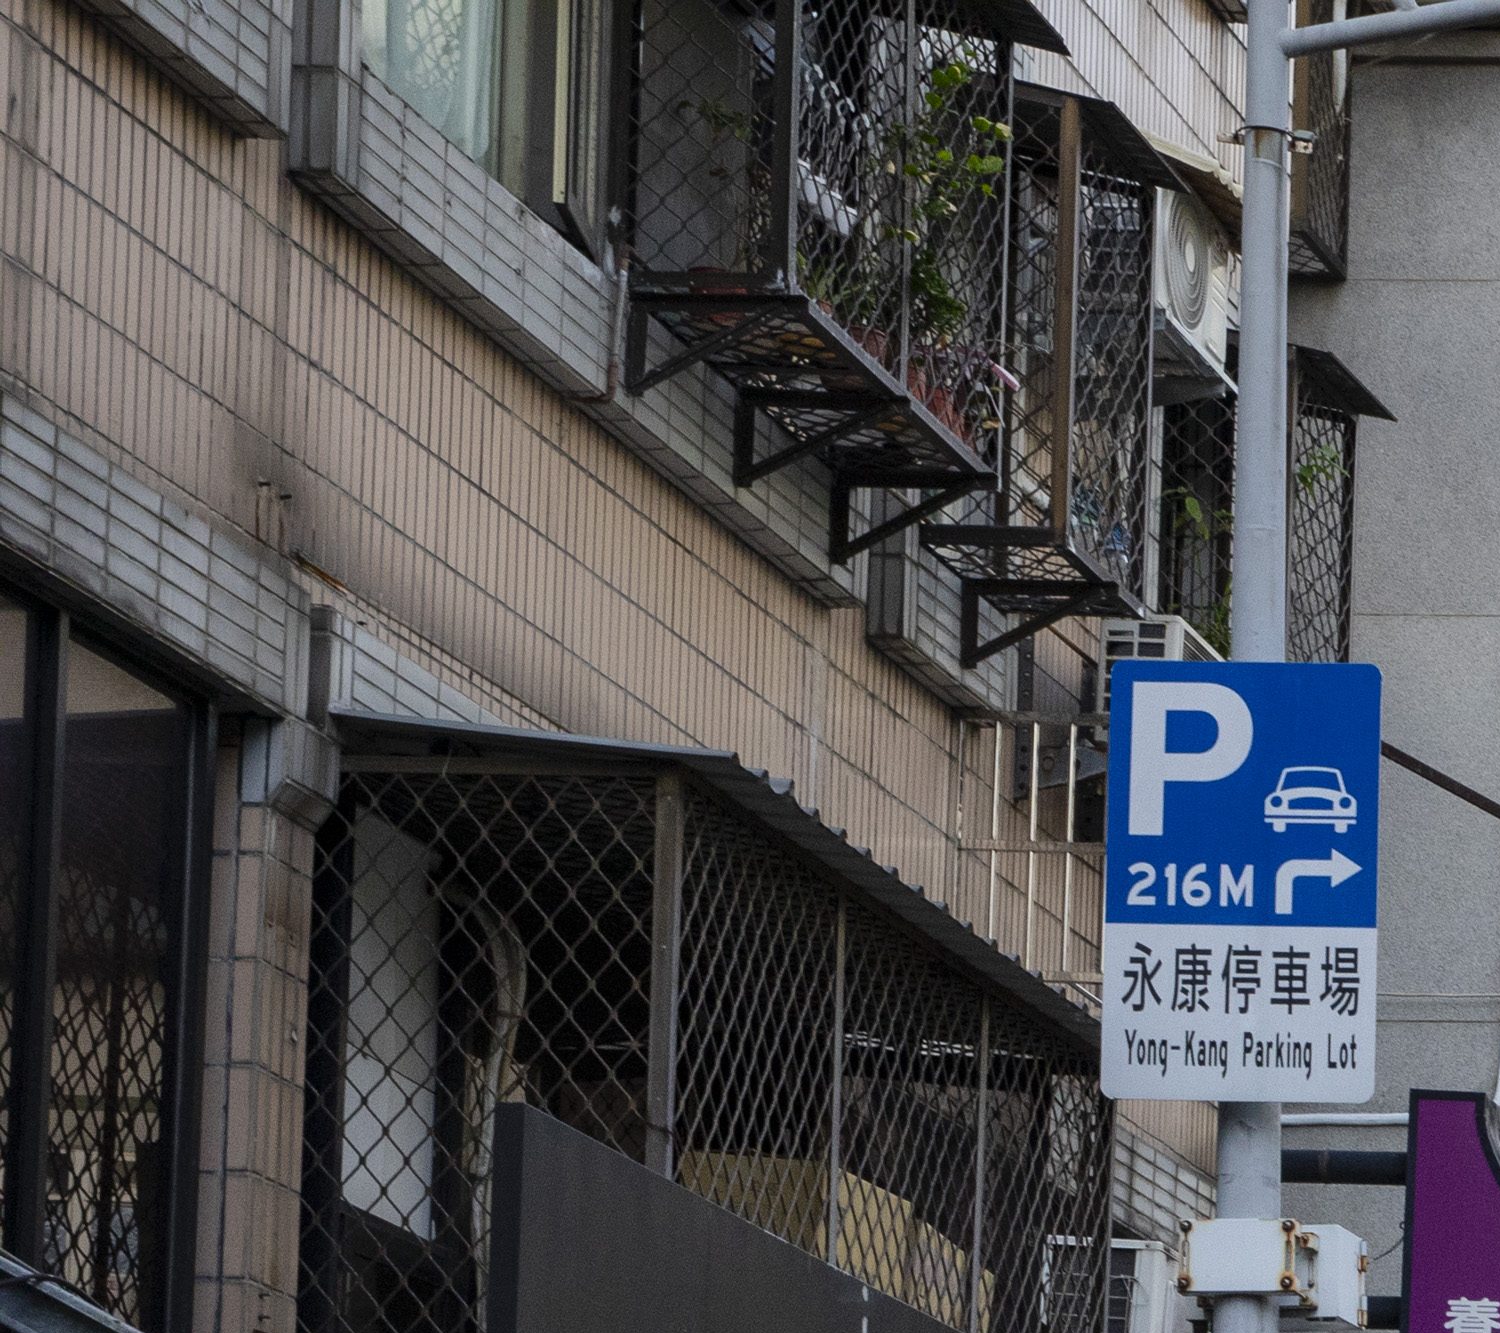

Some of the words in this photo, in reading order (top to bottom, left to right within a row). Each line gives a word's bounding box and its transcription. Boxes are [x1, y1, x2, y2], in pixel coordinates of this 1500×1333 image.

[1128, 682, 1254, 836] P
[1127, 863, 1255, 908] 216M
[1121, 943, 1361, 1016] 永康停車場
[1124, 1031, 1230, 1078] Yong-Kang
[1241, 1032, 1312, 1079] Parking
[1326, 1033, 1358, 1069] Lot
